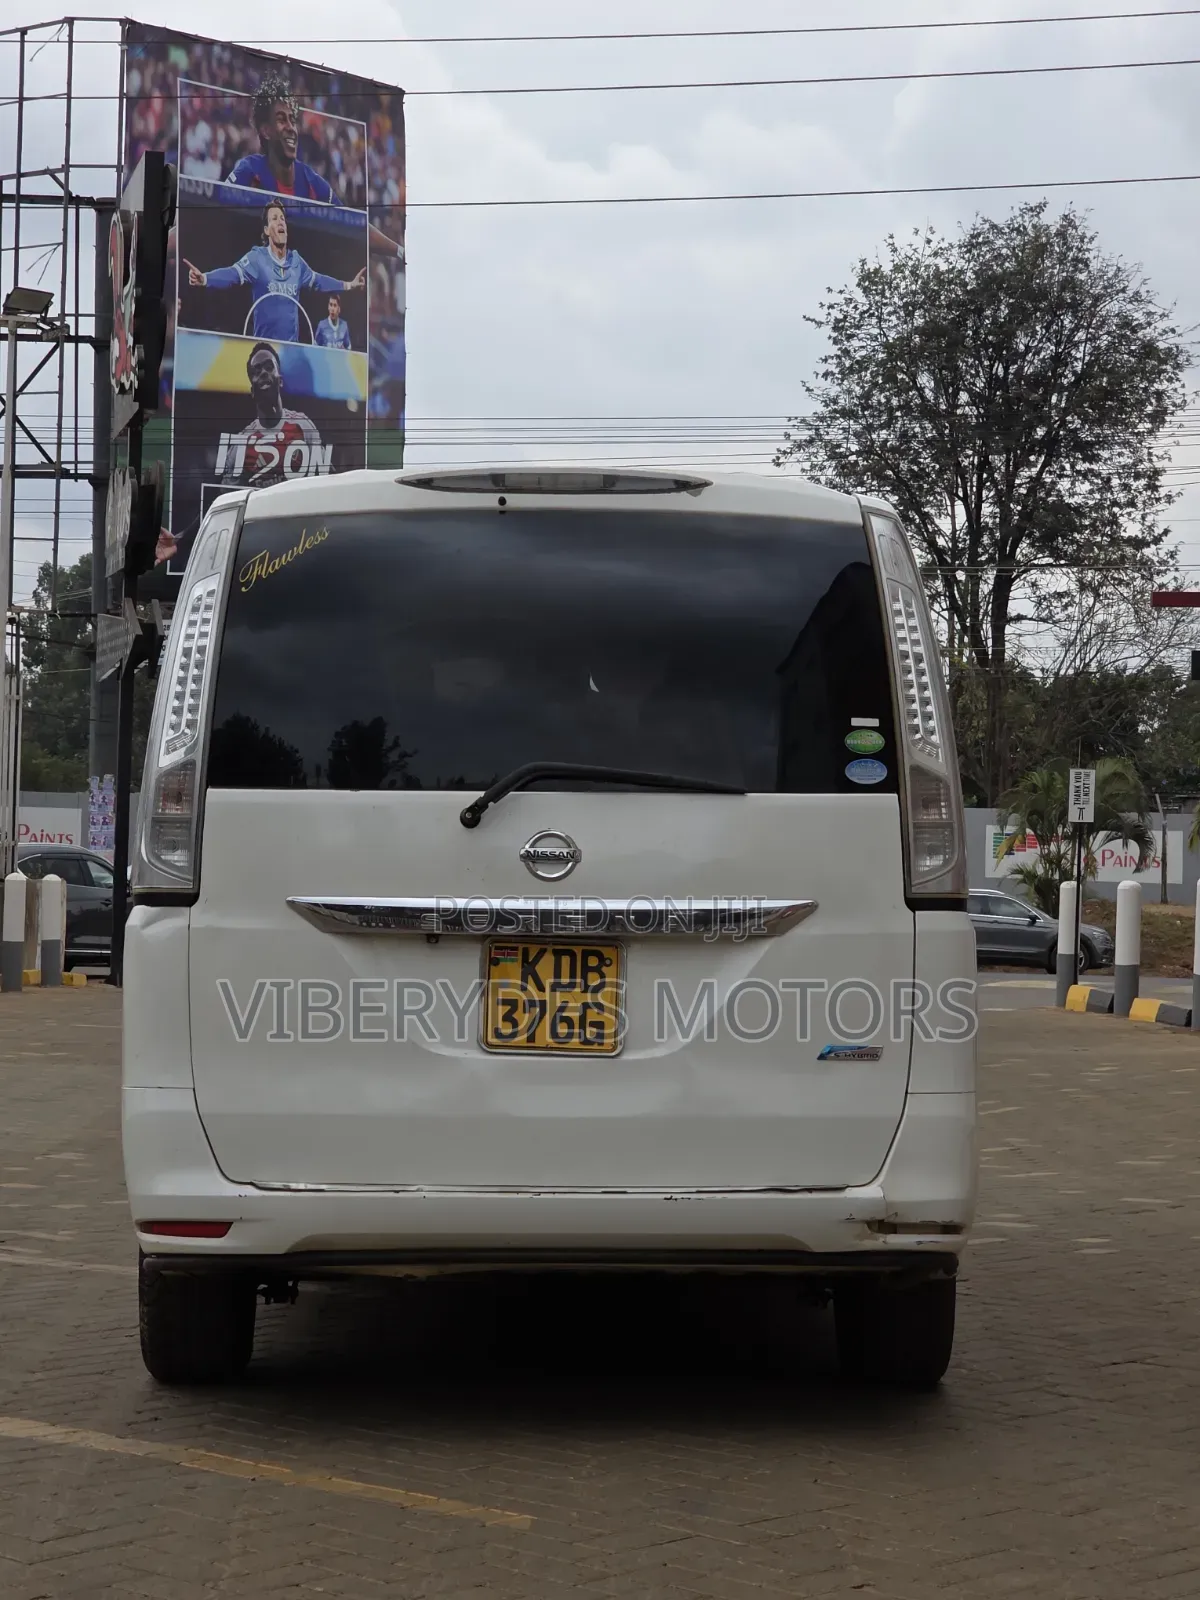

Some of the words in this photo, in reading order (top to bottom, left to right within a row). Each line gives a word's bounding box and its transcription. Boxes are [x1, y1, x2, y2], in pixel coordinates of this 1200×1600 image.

[283, 440, 334, 481] ON
[239, 526, 331, 592] Flawless
[1073, 771, 1083, 784] YOU
[1073, 784, 1082, 806] THANK
[525, 849, 576, 860] NISSAN
[520, 946, 607, 994] KDB
[493, 997, 606, 1047] 376G
